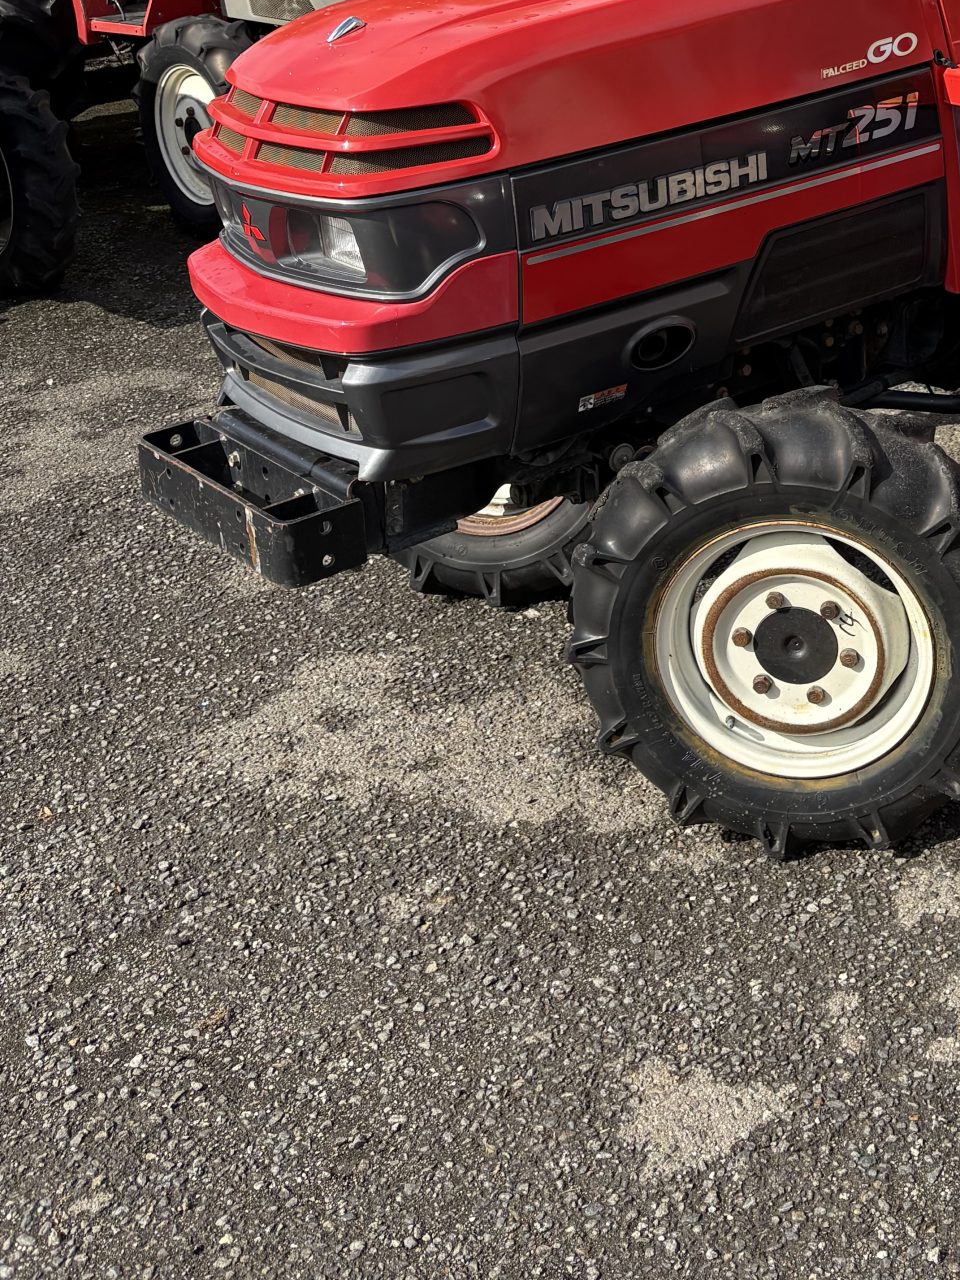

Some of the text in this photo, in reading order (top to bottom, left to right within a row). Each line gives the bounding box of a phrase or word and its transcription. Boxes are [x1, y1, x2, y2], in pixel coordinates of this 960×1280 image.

[822, 32, 918, 79] PALCEED GO
[531, 151, 768, 241] MITSUBISHI
